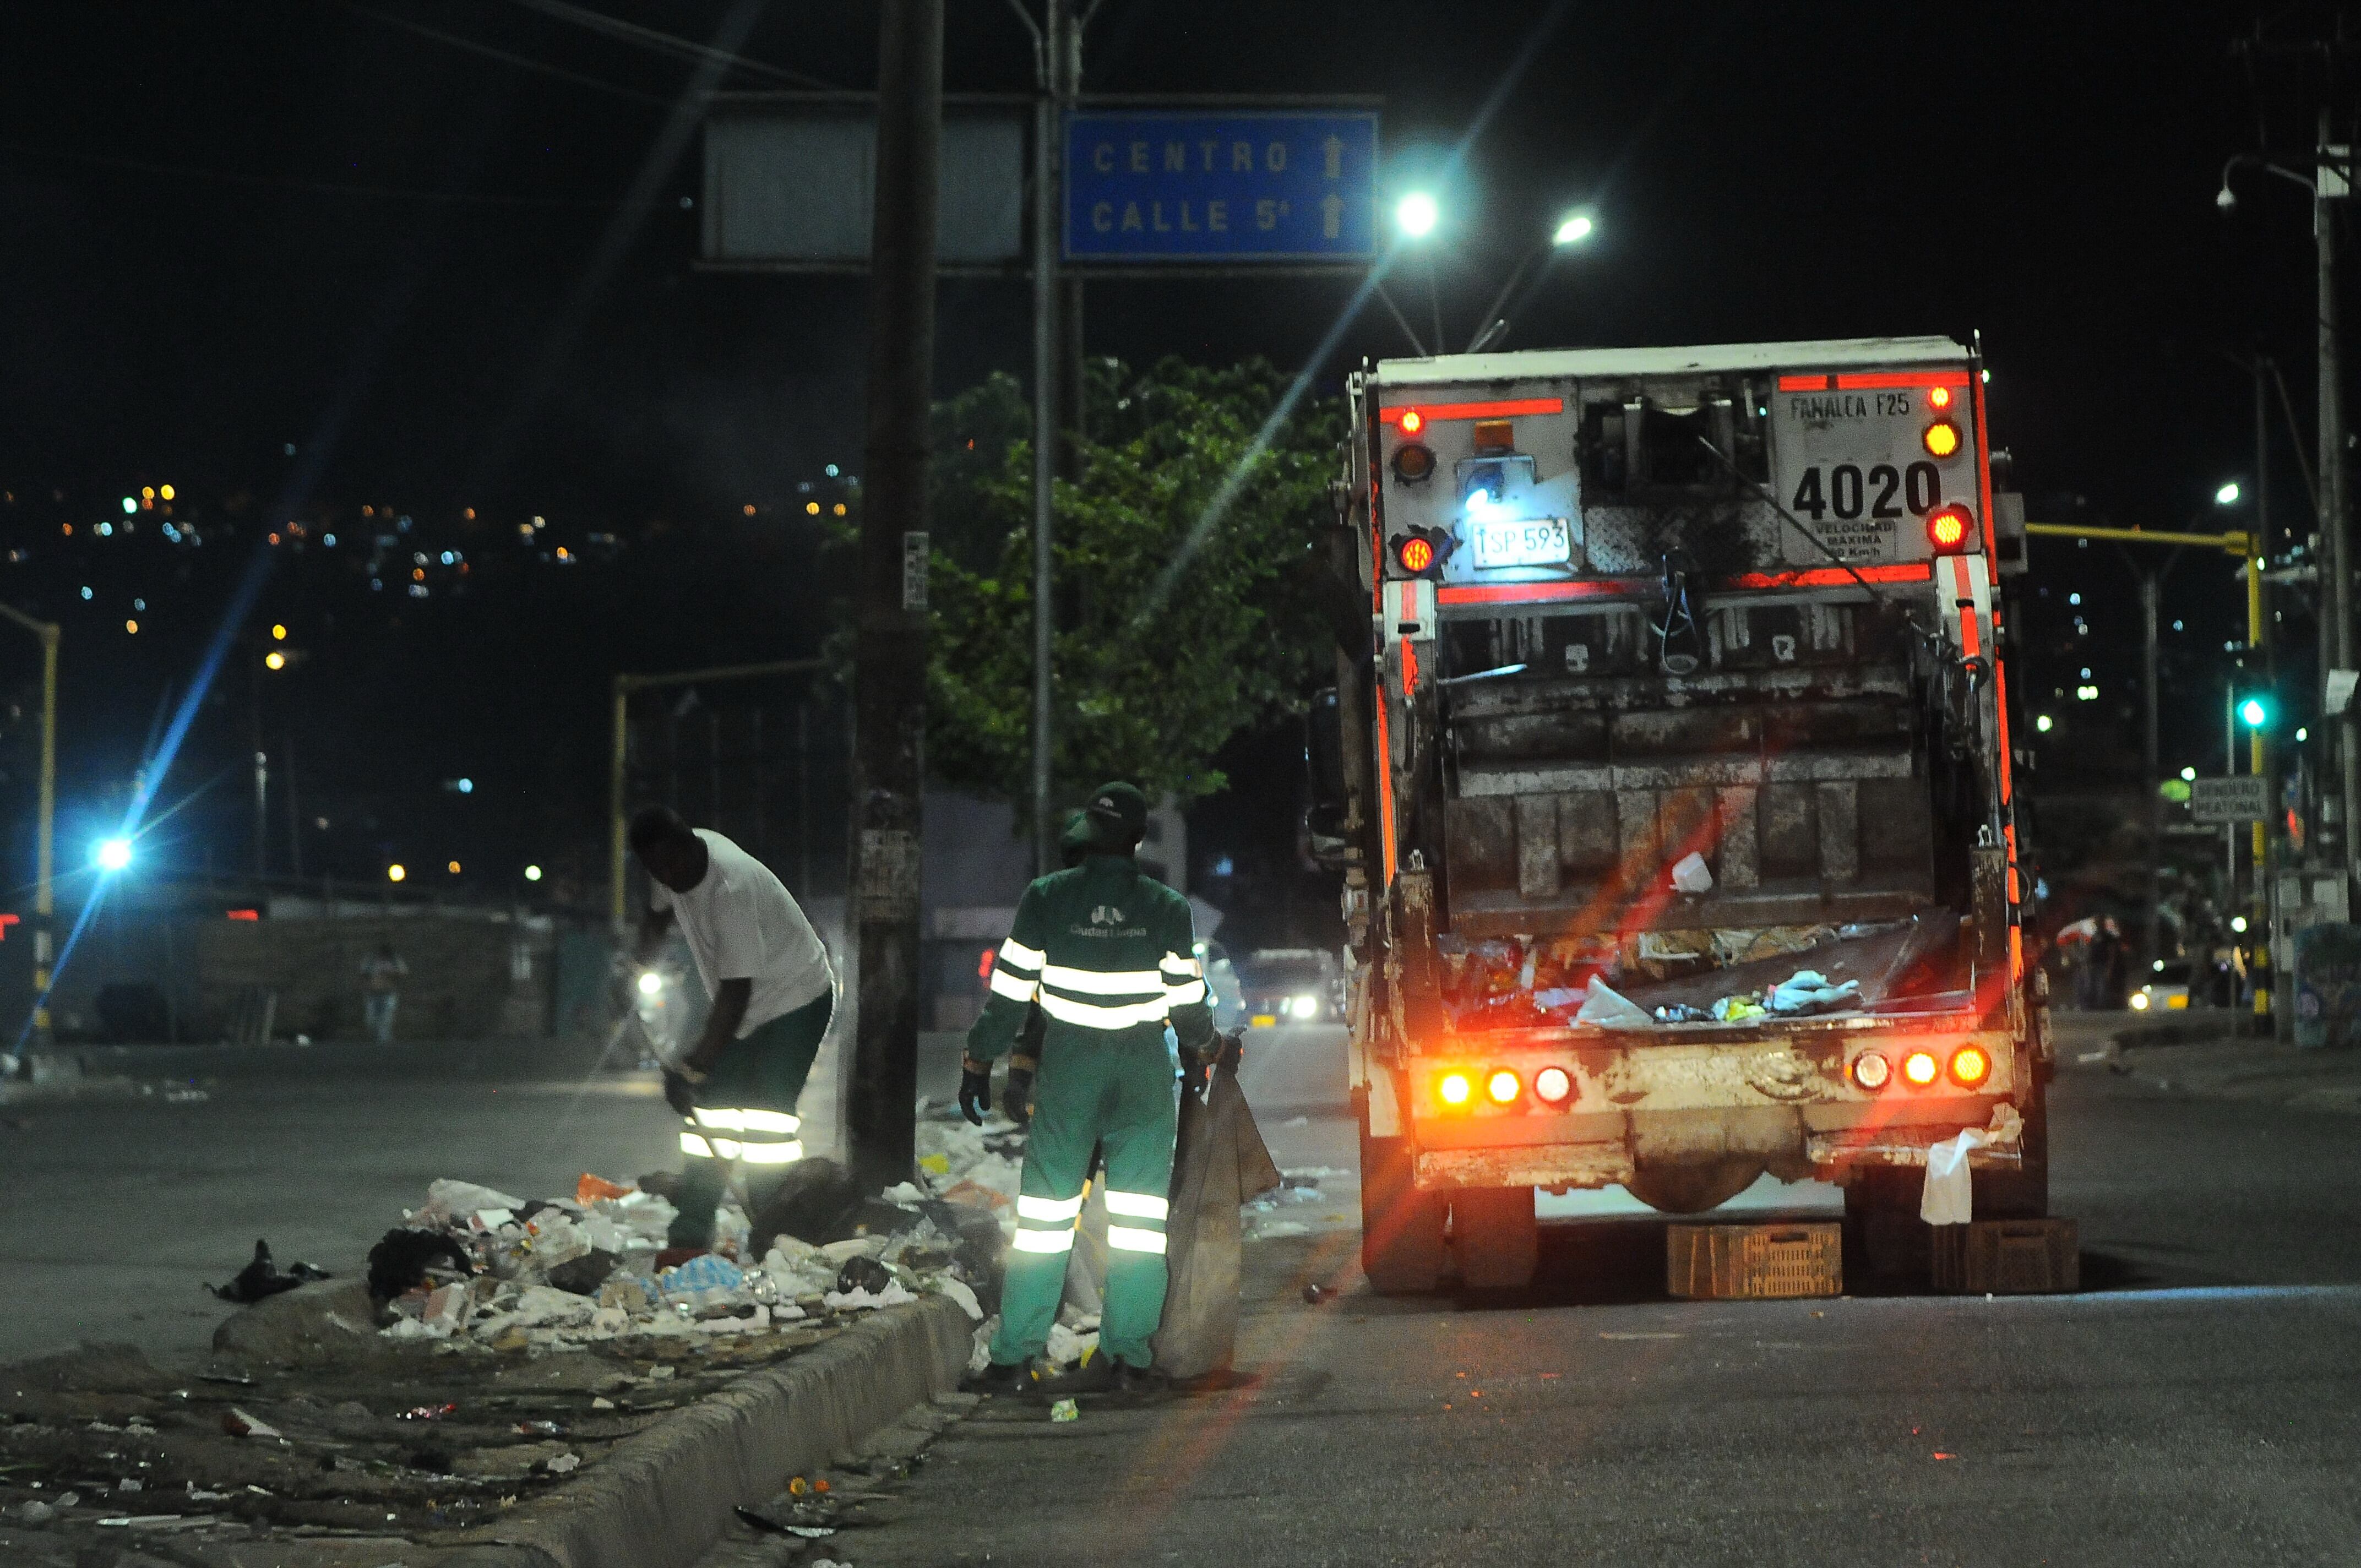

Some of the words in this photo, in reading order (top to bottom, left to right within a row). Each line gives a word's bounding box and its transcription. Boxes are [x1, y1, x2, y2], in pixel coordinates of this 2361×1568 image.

[1094, 140, 1287, 173] CENTRO
[1093, 199, 1229, 232] CALLE
[1876, 393, 1910, 416] F25
[1793, 461, 1941, 520] 4020
[1524, 525, 1565, 550] 593
[1816, 521, 1892, 533] VELOCIDAD
[1827, 534, 1881, 545] MAXIMA
